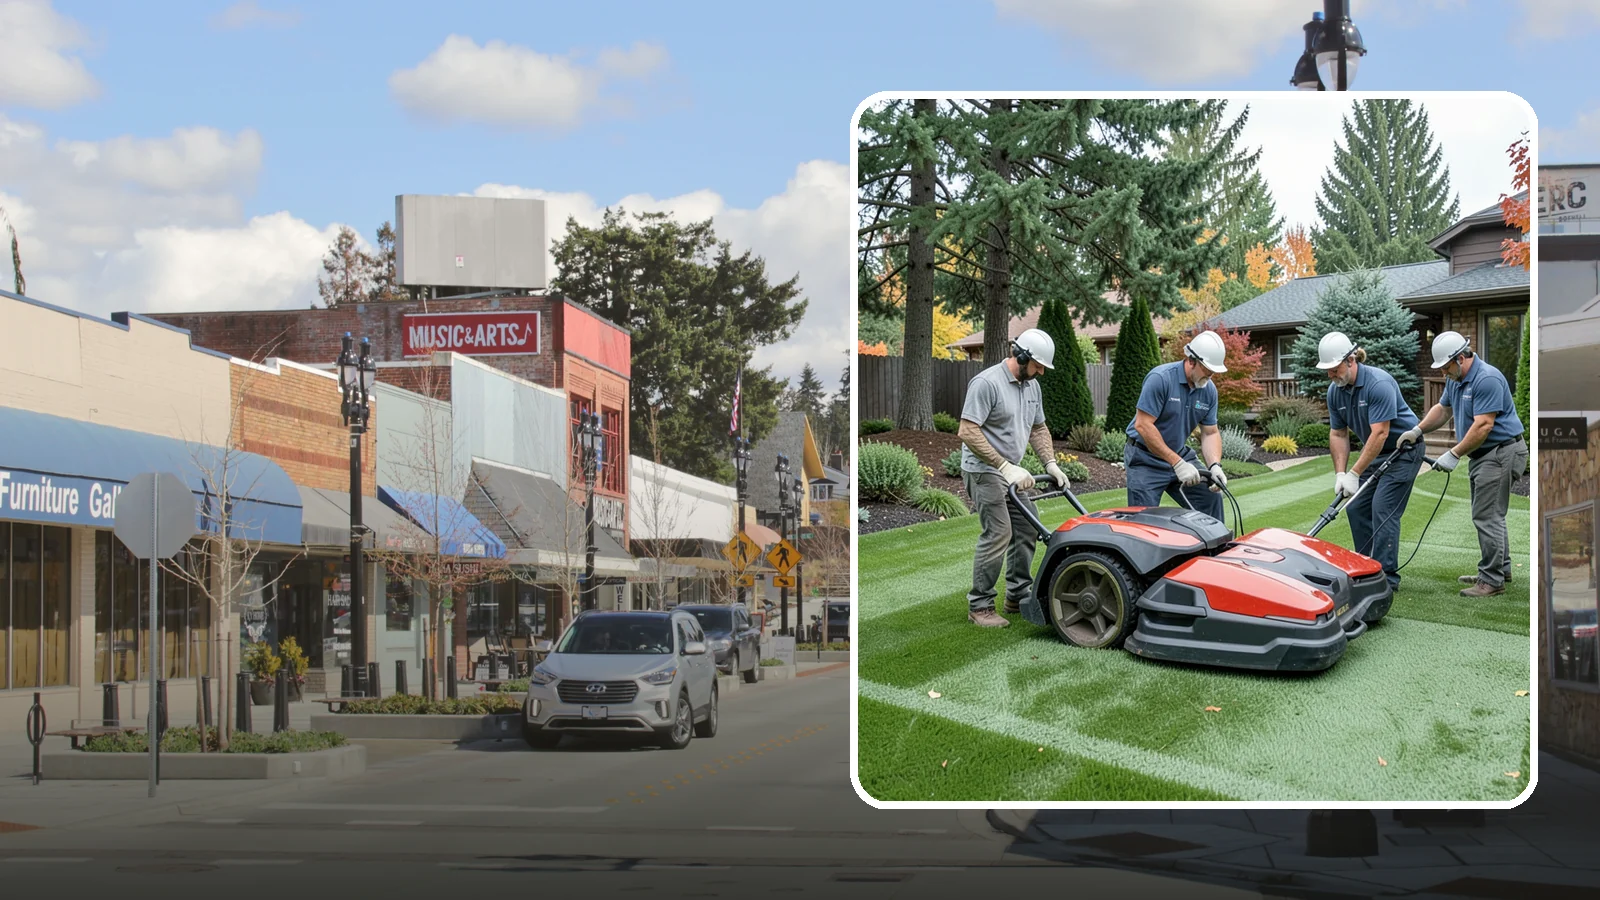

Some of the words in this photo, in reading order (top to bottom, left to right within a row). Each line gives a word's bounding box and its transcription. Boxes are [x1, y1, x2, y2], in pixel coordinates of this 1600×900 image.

[409, 323, 520, 349] MUSIC&ARTS
[0, 471, 79, 515] Furniture
[89, 482, 122, 519] Gal
